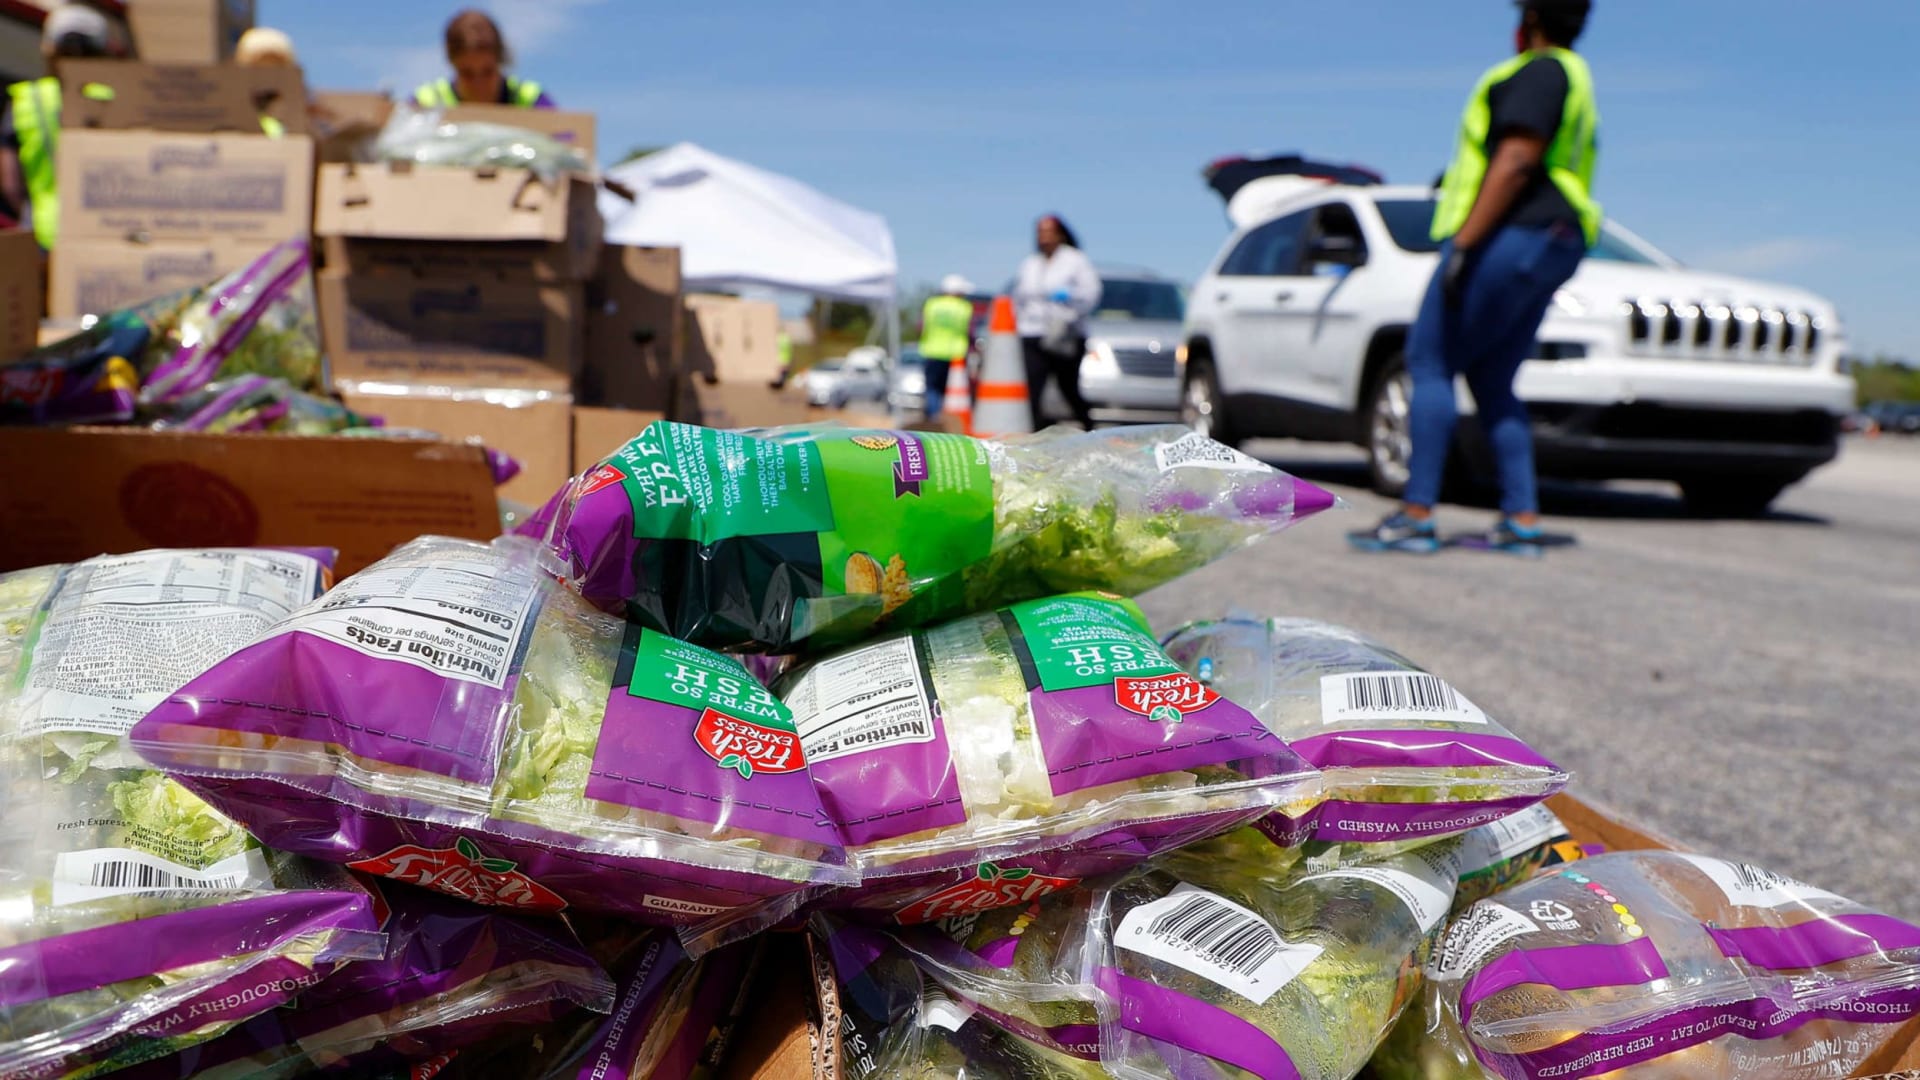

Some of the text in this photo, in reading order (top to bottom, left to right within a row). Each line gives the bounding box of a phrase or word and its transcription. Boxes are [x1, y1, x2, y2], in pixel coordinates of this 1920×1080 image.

[687, 454, 699, 474] ARE
[694, 440, 714, 504] DELICIOUSLY
[767, 458, 776, 481] SEAL
[776, 456, 784, 470] TO
[798, 447, 809, 484] DELIVER
[905, 446, 923, 475] FRESH
[631, 465, 657, 508] WHY
[755, 446, 770, 506] THOROUGHLY
[778, 471, 787, 490] BAG
[692, 476, 707, 515] SALADS
[722, 482, 732, 508] COOL
[769, 482, 778, 507] THEN
[437, 601, 513, 631] Calories
[346, 624, 496, 682] Nutrition Facts
[347, 615, 501, 667] About 2.5 servings per container
[444, 626, 505, 657] Serving size
[1076, 664, 1106, 676] SO
[1128, 676, 1194, 690] XPRESS
[671, 682, 781, 721] WE'RE SO
[848, 681, 914, 705] Calories
[1131, 682, 1208, 711] Fresh
[843, 721, 879, 735] servings
[896, 708, 923, 721] About
[714, 717, 793, 746] EXPRESS
[807, 720, 925, 757] Nutrition Fac
[711, 729, 791, 768] Fresh
[57, 819, 85, 830] Fresh
[1337, 819, 1401, 833] WASHED
[124, 836, 206, 866] Proof of Purchase
[171, 843, 201, 857] Caesar
[650, 898, 726, 914] GUARANT
[923, 877, 1056, 921] Fresh
[1546, 919, 1581, 931] OTHER
[1134, 926, 1143, 936] 0
[1154, 931, 1194, 952] 71279
[1250, 977, 1260, 985] 7
[188, 971, 324, 1019] THOROUGHLY
[602, 940, 661, 1052] REFRIGERATED
[1671, 1023, 1694, 1041] EAT
[1696, 1019, 1711, 1034] TO
[1713, 1013, 1757, 1031] READY
[1626, 1035, 1655, 1055] KEEP
[1537, 1043, 1624, 1078] REFRIGERATED
